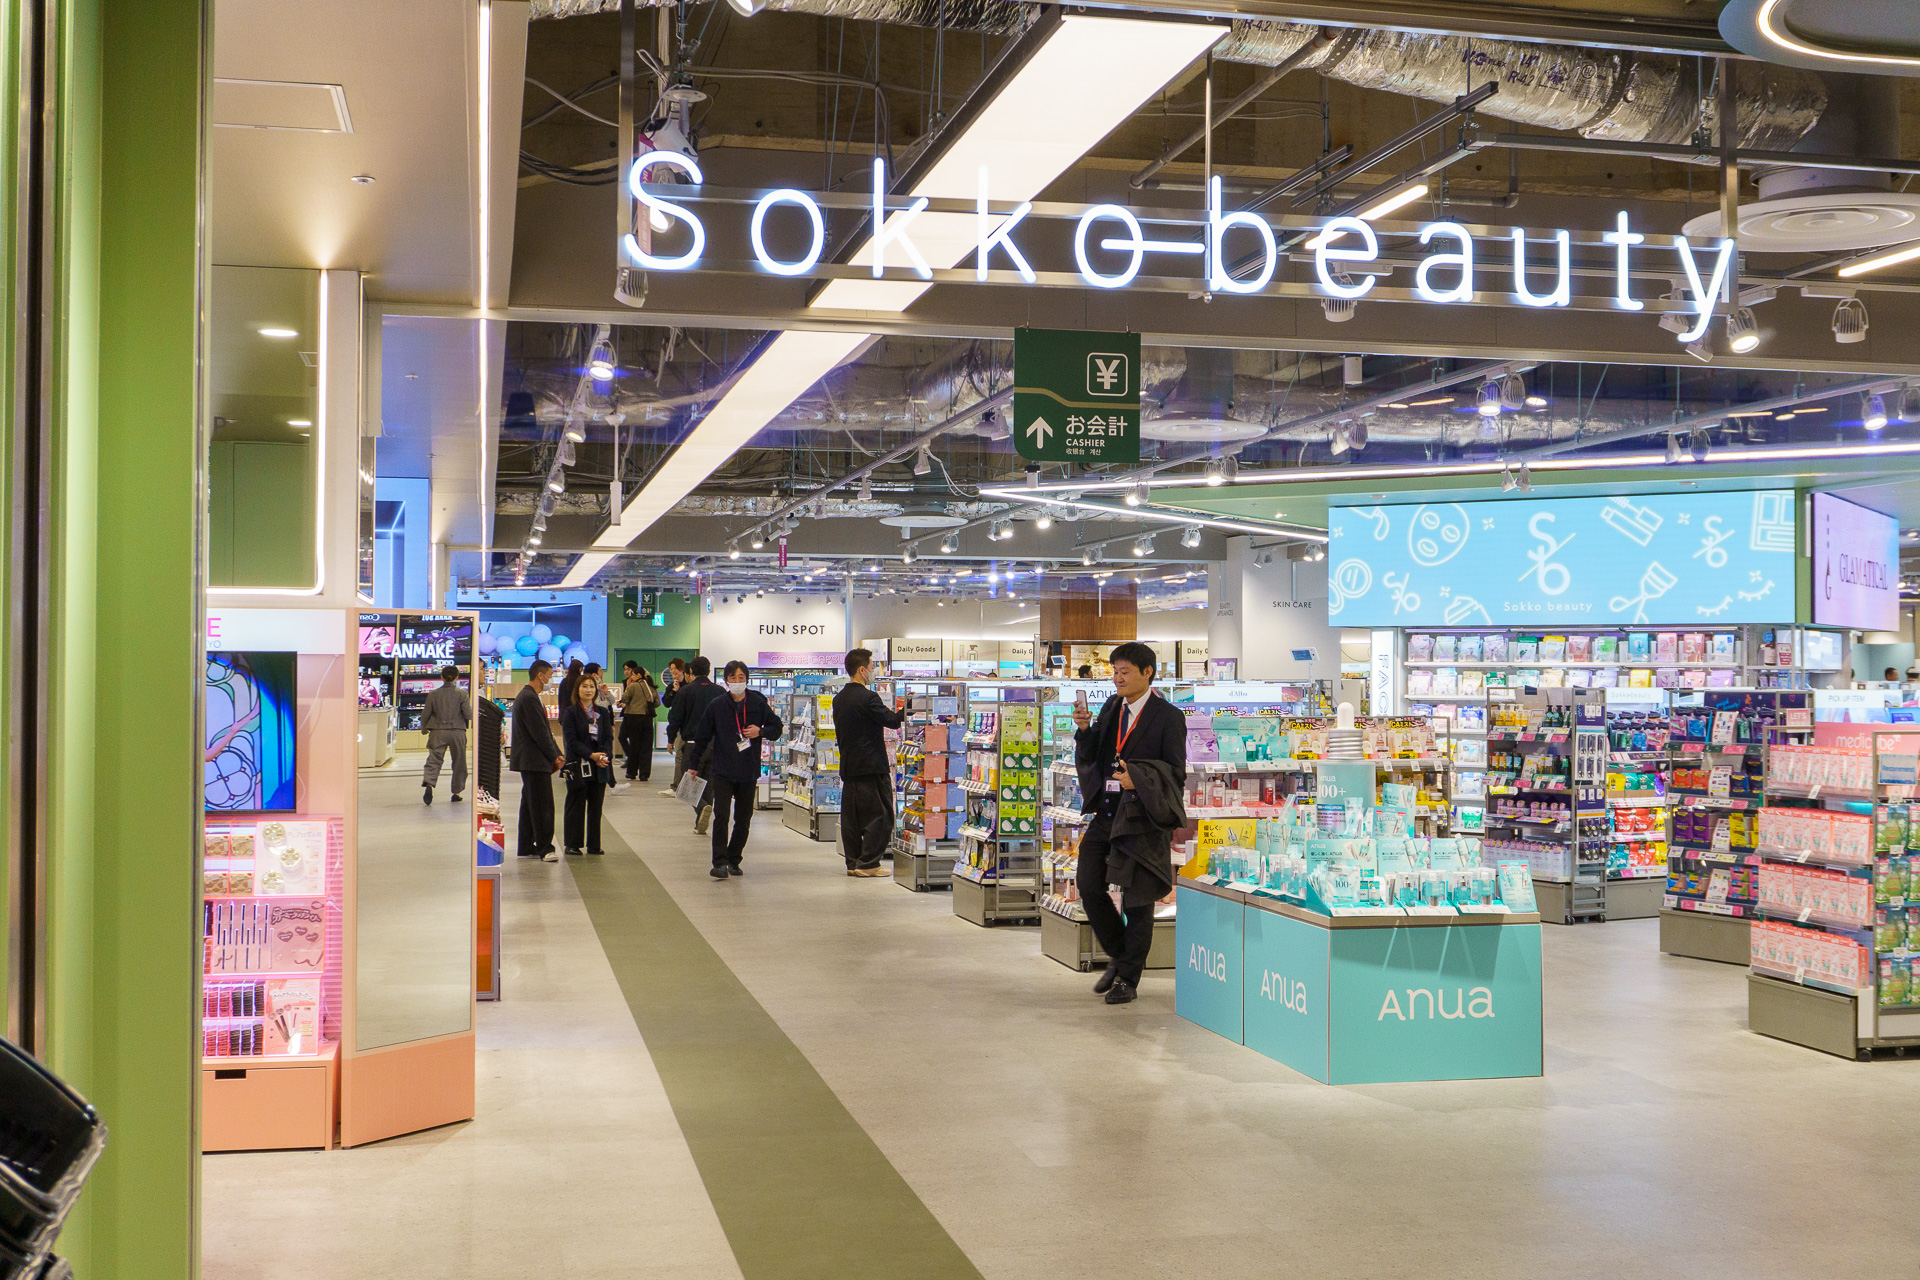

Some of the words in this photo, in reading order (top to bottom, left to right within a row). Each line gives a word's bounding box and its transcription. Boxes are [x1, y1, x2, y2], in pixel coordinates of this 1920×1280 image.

[1065, 415, 1128, 437] お会計
[1065, 438, 1105, 448] CASHIER
[1292, 601, 1312, 609] CARE
[1503, 601, 1542, 612] Sokko
[1547, 601, 1593, 614] beauty
[759, 624, 786, 635] FUN
[792, 624, 826, 635] SPOT
[380, 643, 455, 659] CANMAKE
[897, 646, 914, 654] Daily
[1187, 648, 1204, 656] Daily
[1088, 689, 1117, 699] Anu
[1836, 733, 1895, 751] medicbe
[1188, 942, 1227, 983] Anua
[1260, 968, 1308, 1015] Anua
[1377, 986, 1496, 1022] Anua
